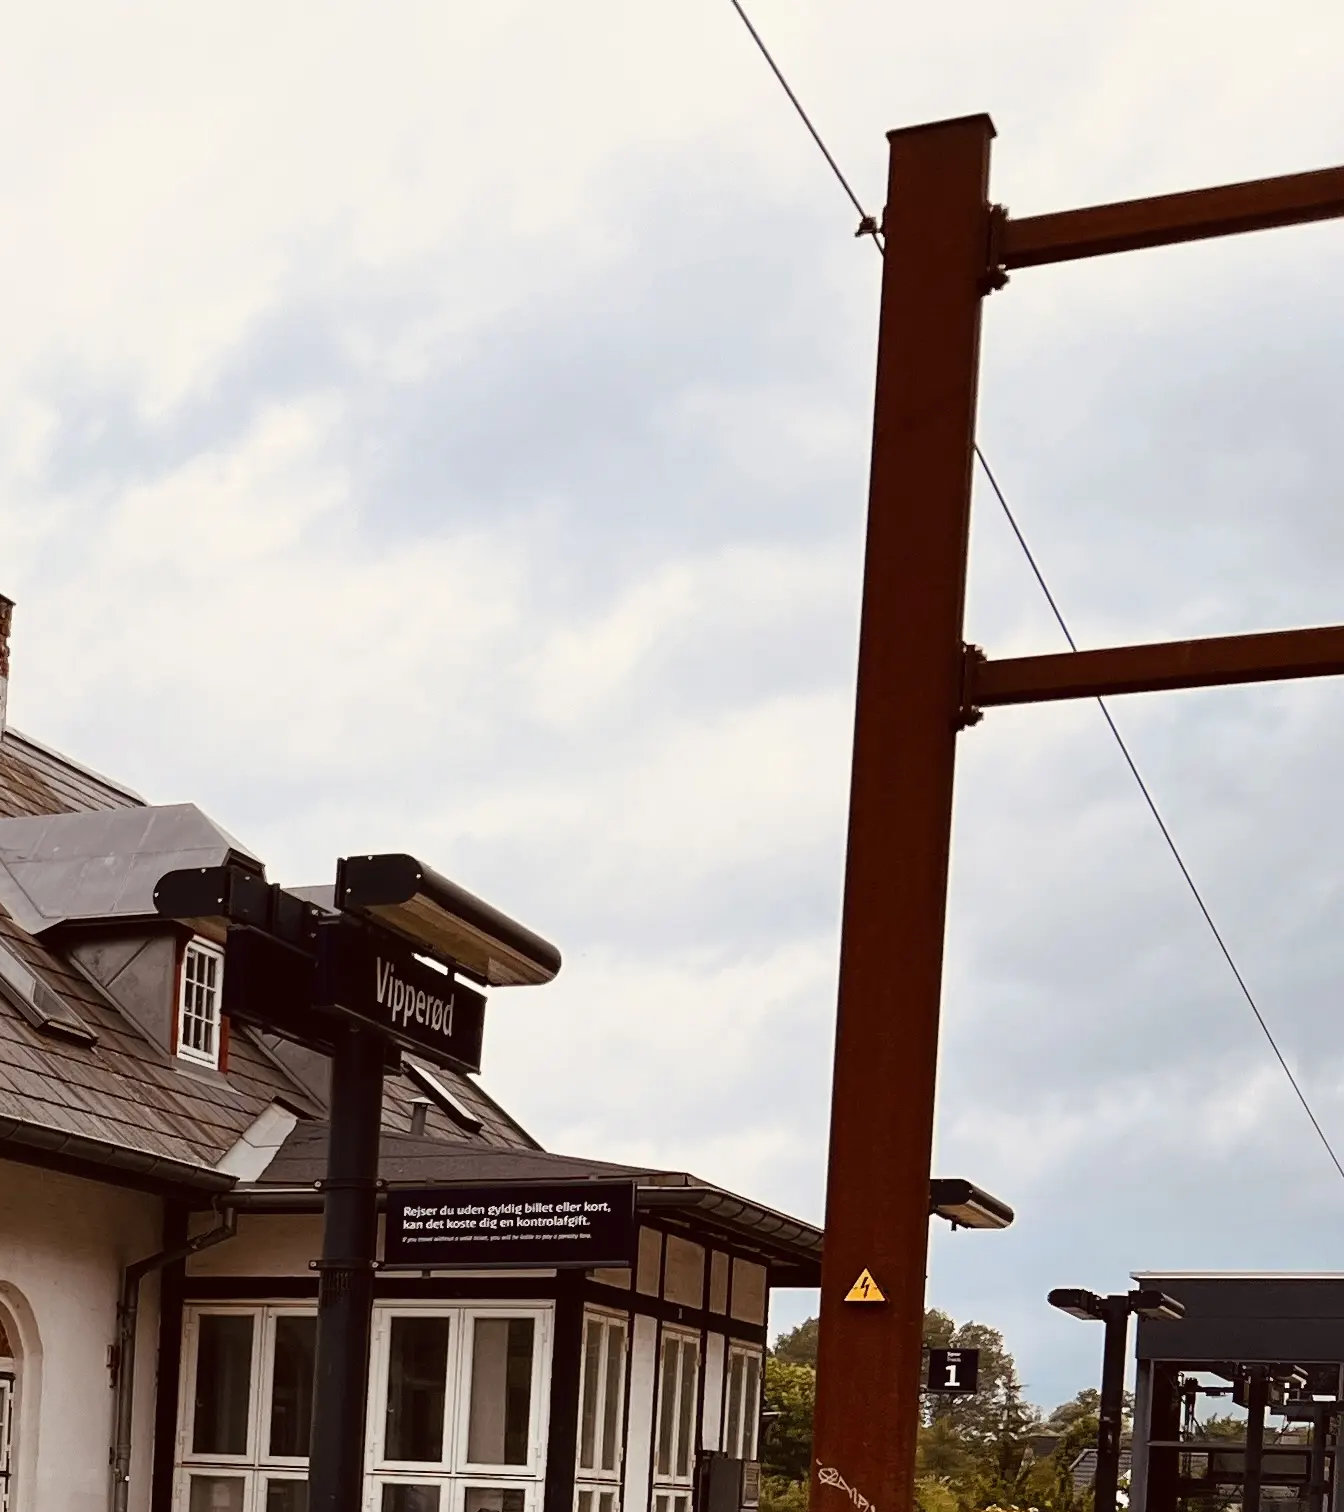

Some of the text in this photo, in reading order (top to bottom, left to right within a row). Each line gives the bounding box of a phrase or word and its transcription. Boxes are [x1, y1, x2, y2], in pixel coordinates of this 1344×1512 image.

[376, 957, 455, 1037] Vipperød
[403, 1200, 612, 1218] Rejser du uden gyldig billet eller kort,
[402, 1215, 591, 1229] kan det koste dig en kontrolafgift.
[944, 1365, 960, 1387] 1
